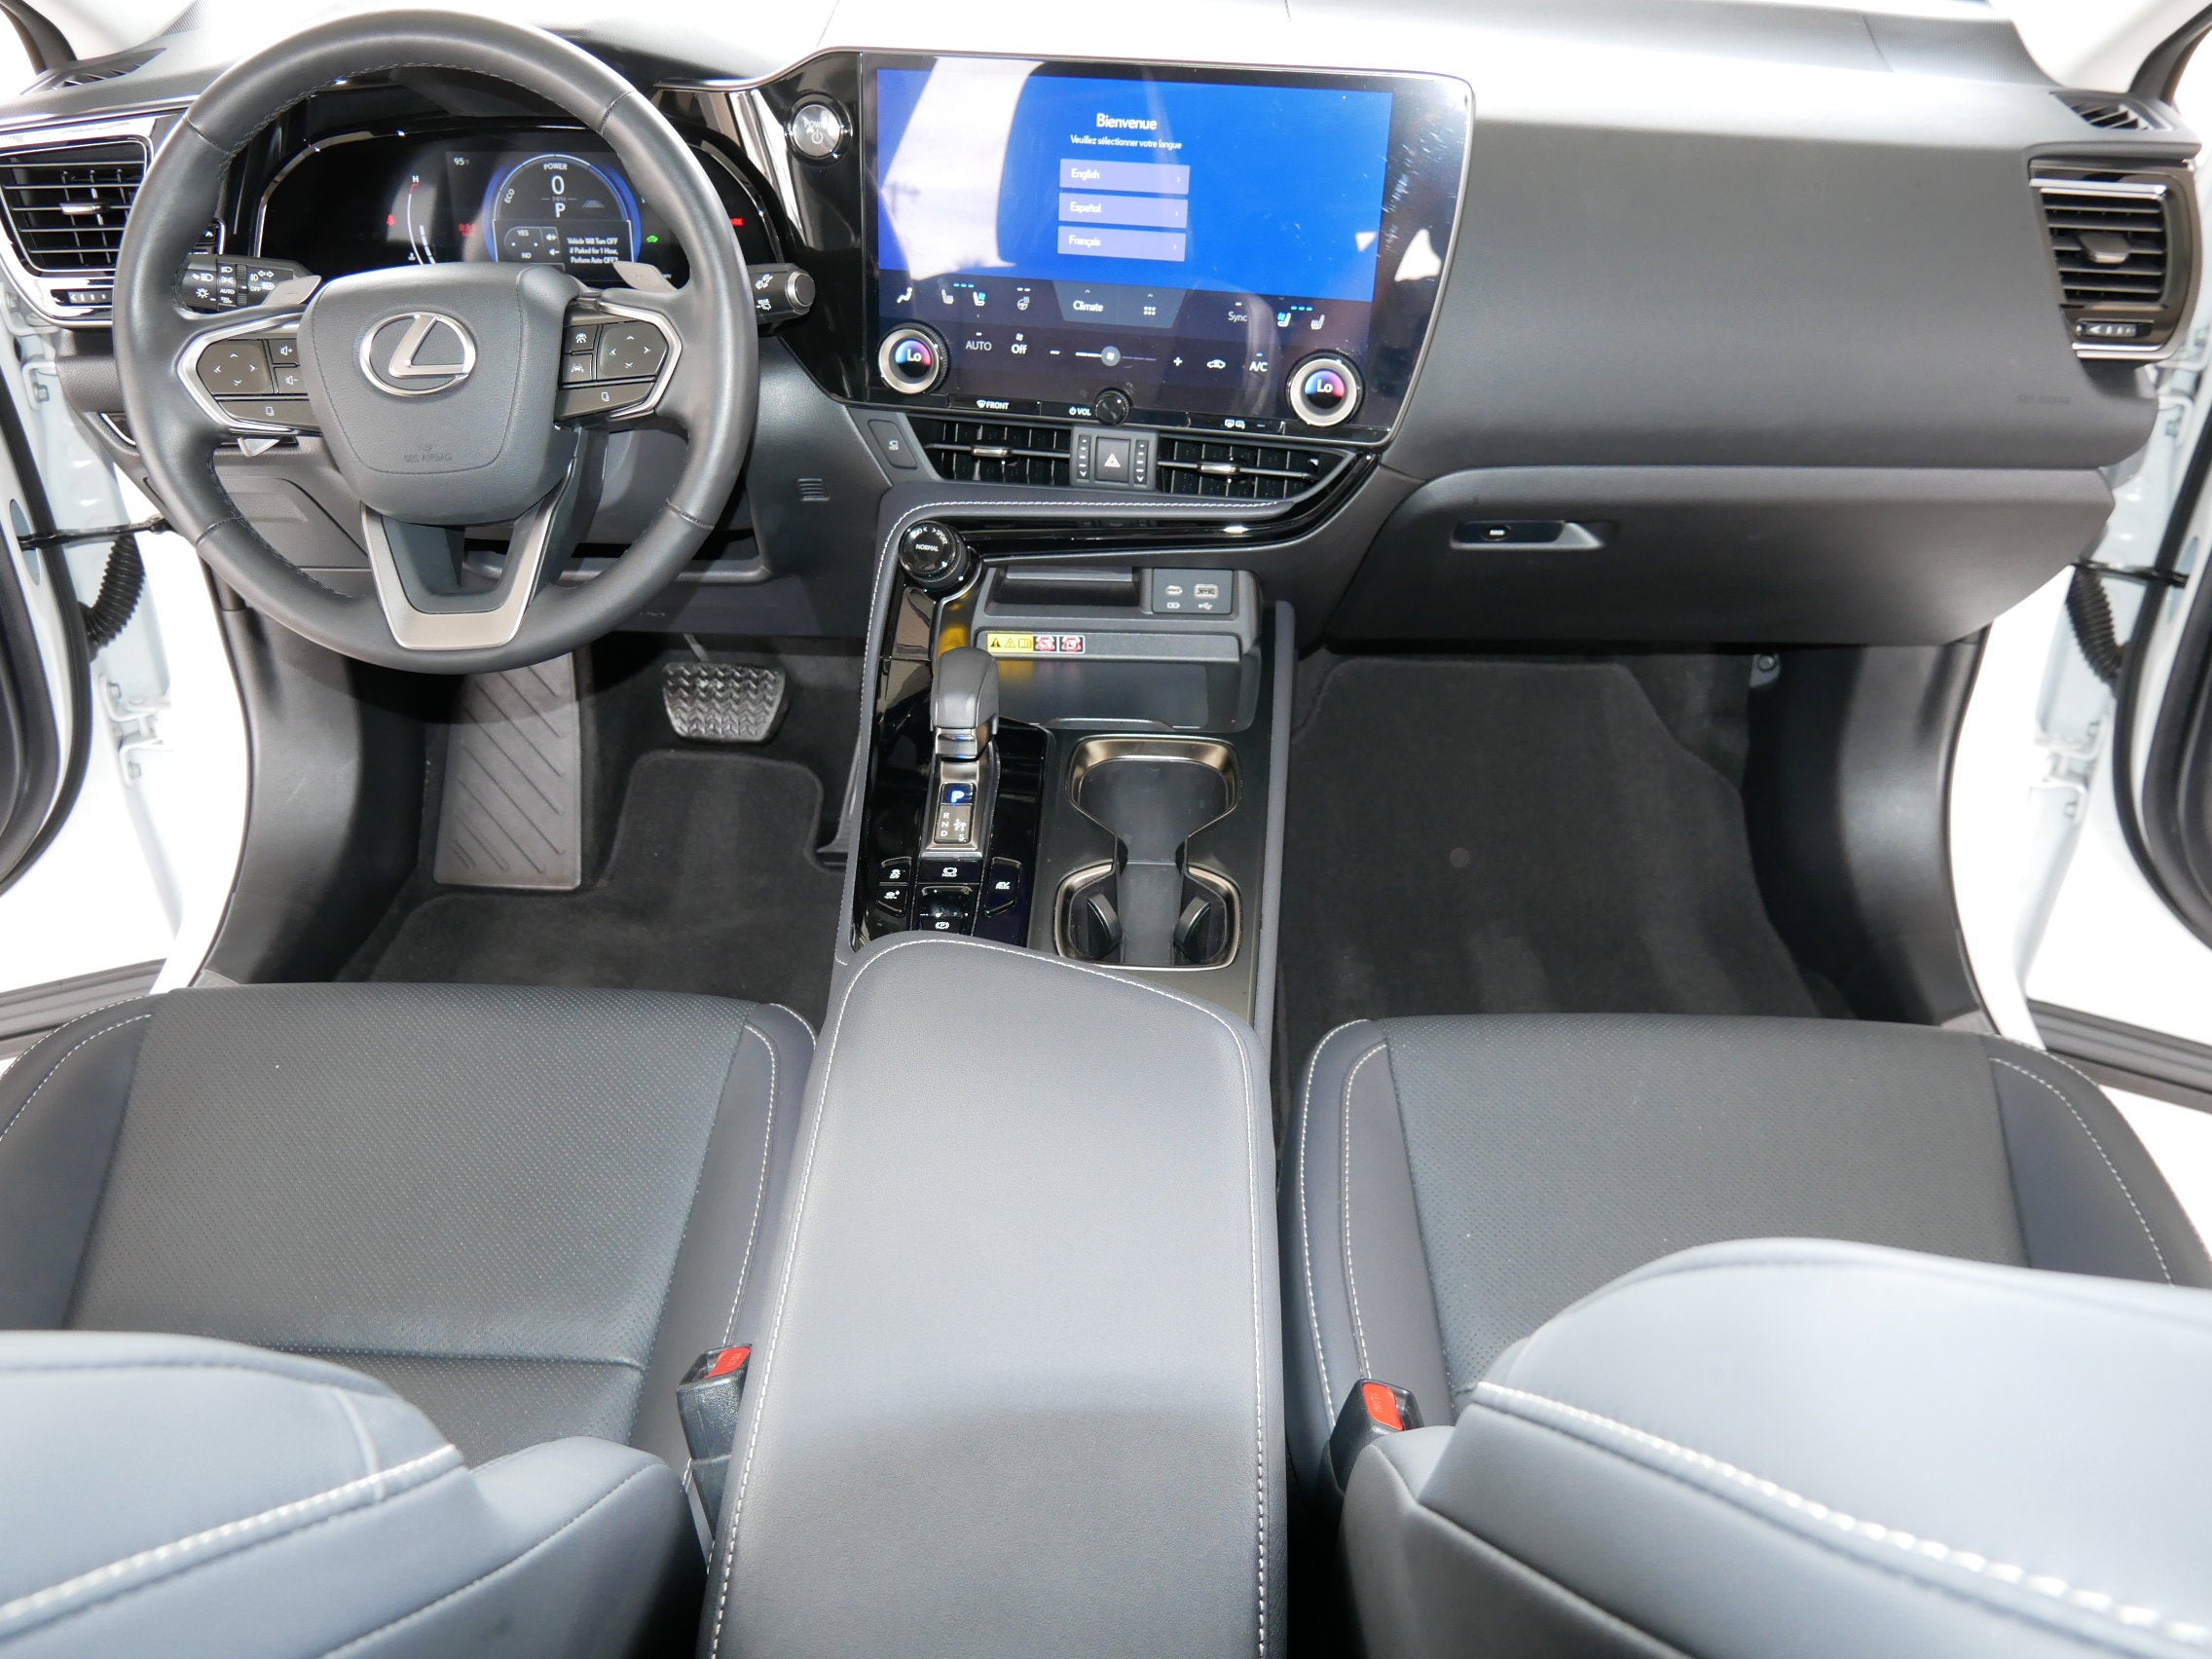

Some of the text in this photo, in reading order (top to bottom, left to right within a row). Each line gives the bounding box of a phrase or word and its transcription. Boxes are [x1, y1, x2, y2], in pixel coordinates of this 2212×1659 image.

[1096, 113, 1158, 129] Bienvenue
[1070, 134, 1182, 150] Veuillez sélectionner votre langue
[543, 163, 568, 171] POWER
[1071, 168, 1100, 181] English
[550, 175, 565, 195] 0
[504, 188, 515, 203] ECO
[555, 203, 566, 218] P
[1070, 202, 1101, 214] Español
[1068, 235, 1101, 248] Français
[1073, 301, 1103, 313] Climate
[1228, 312, 1247, 324] Sync
[965, 340, 992, 351] AUTO
[1011, 344, 1027, 354] Off
[907, 349, 922, 362] Lo
[1249, 361, 1268, 372] A/C
[1317, 379, 1333, 393] Lo
[986, 401, 1010, 410] FRONT
[1077, 408, 1091, 417] VOL
[951, 791, 964, 803] P
